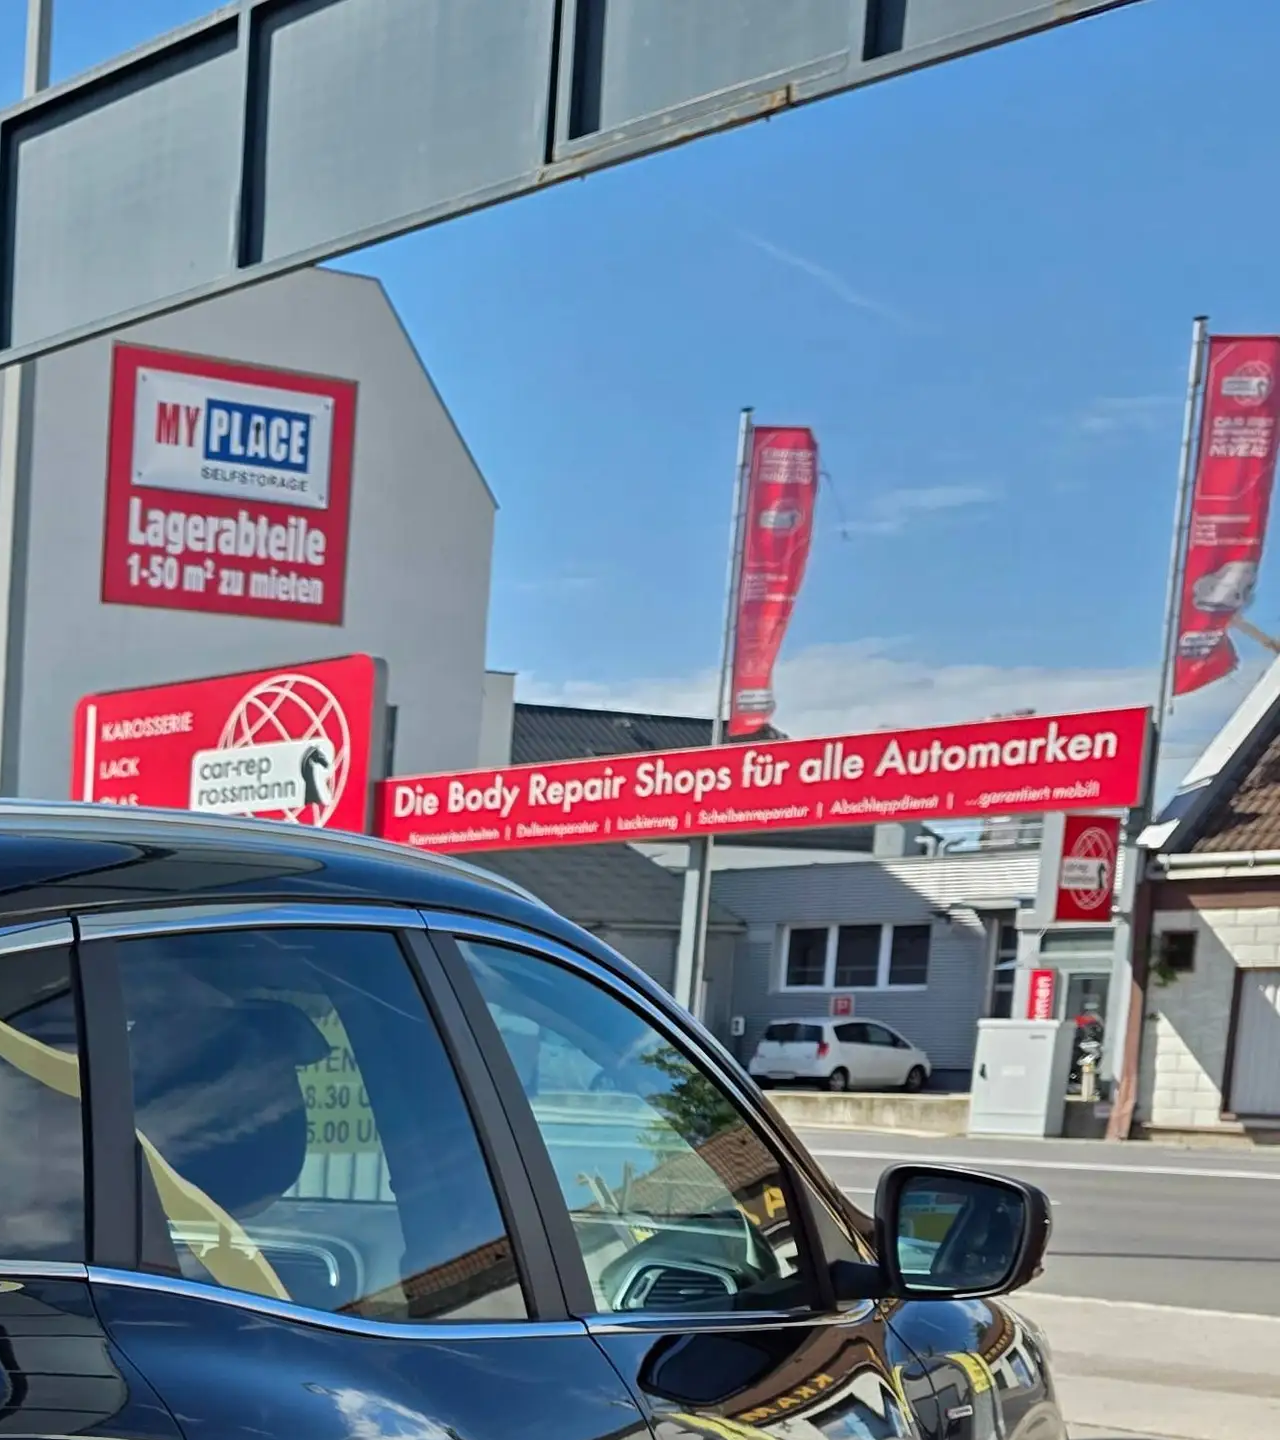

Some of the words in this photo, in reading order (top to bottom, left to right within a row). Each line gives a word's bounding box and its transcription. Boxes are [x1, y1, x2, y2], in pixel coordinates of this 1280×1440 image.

[156, 400, 201, 448] MY
[208, 407, 308, 465] PLACE
[201, 465, 309, 493] SELFSTORAGE
[128, 496, 326, 566] Lagerabteile
[127, 551, 179, 590] 1-50
[218, 567, 245, 597] zu
[249, 565, 324, 605] mieten
[101, 710, 194, 742] KAROSSERIE
[99, 756, 141, 780] LACK
[198, 755, 272, 783] car-rep
[394, 785, 439, 817] Die
[447, 774, 520, 818] Body
[528, 767, 627, 813] Repair
[634, 758, 732, 802] Shops
[741, 750, 790, 788] für
[799, 742, 865, 783] alle
[874, 722, 1118, 777] Automarken
[197, 779, 297, 806] rossmann
[829, 794, 940, 816] Abschleppdienst
